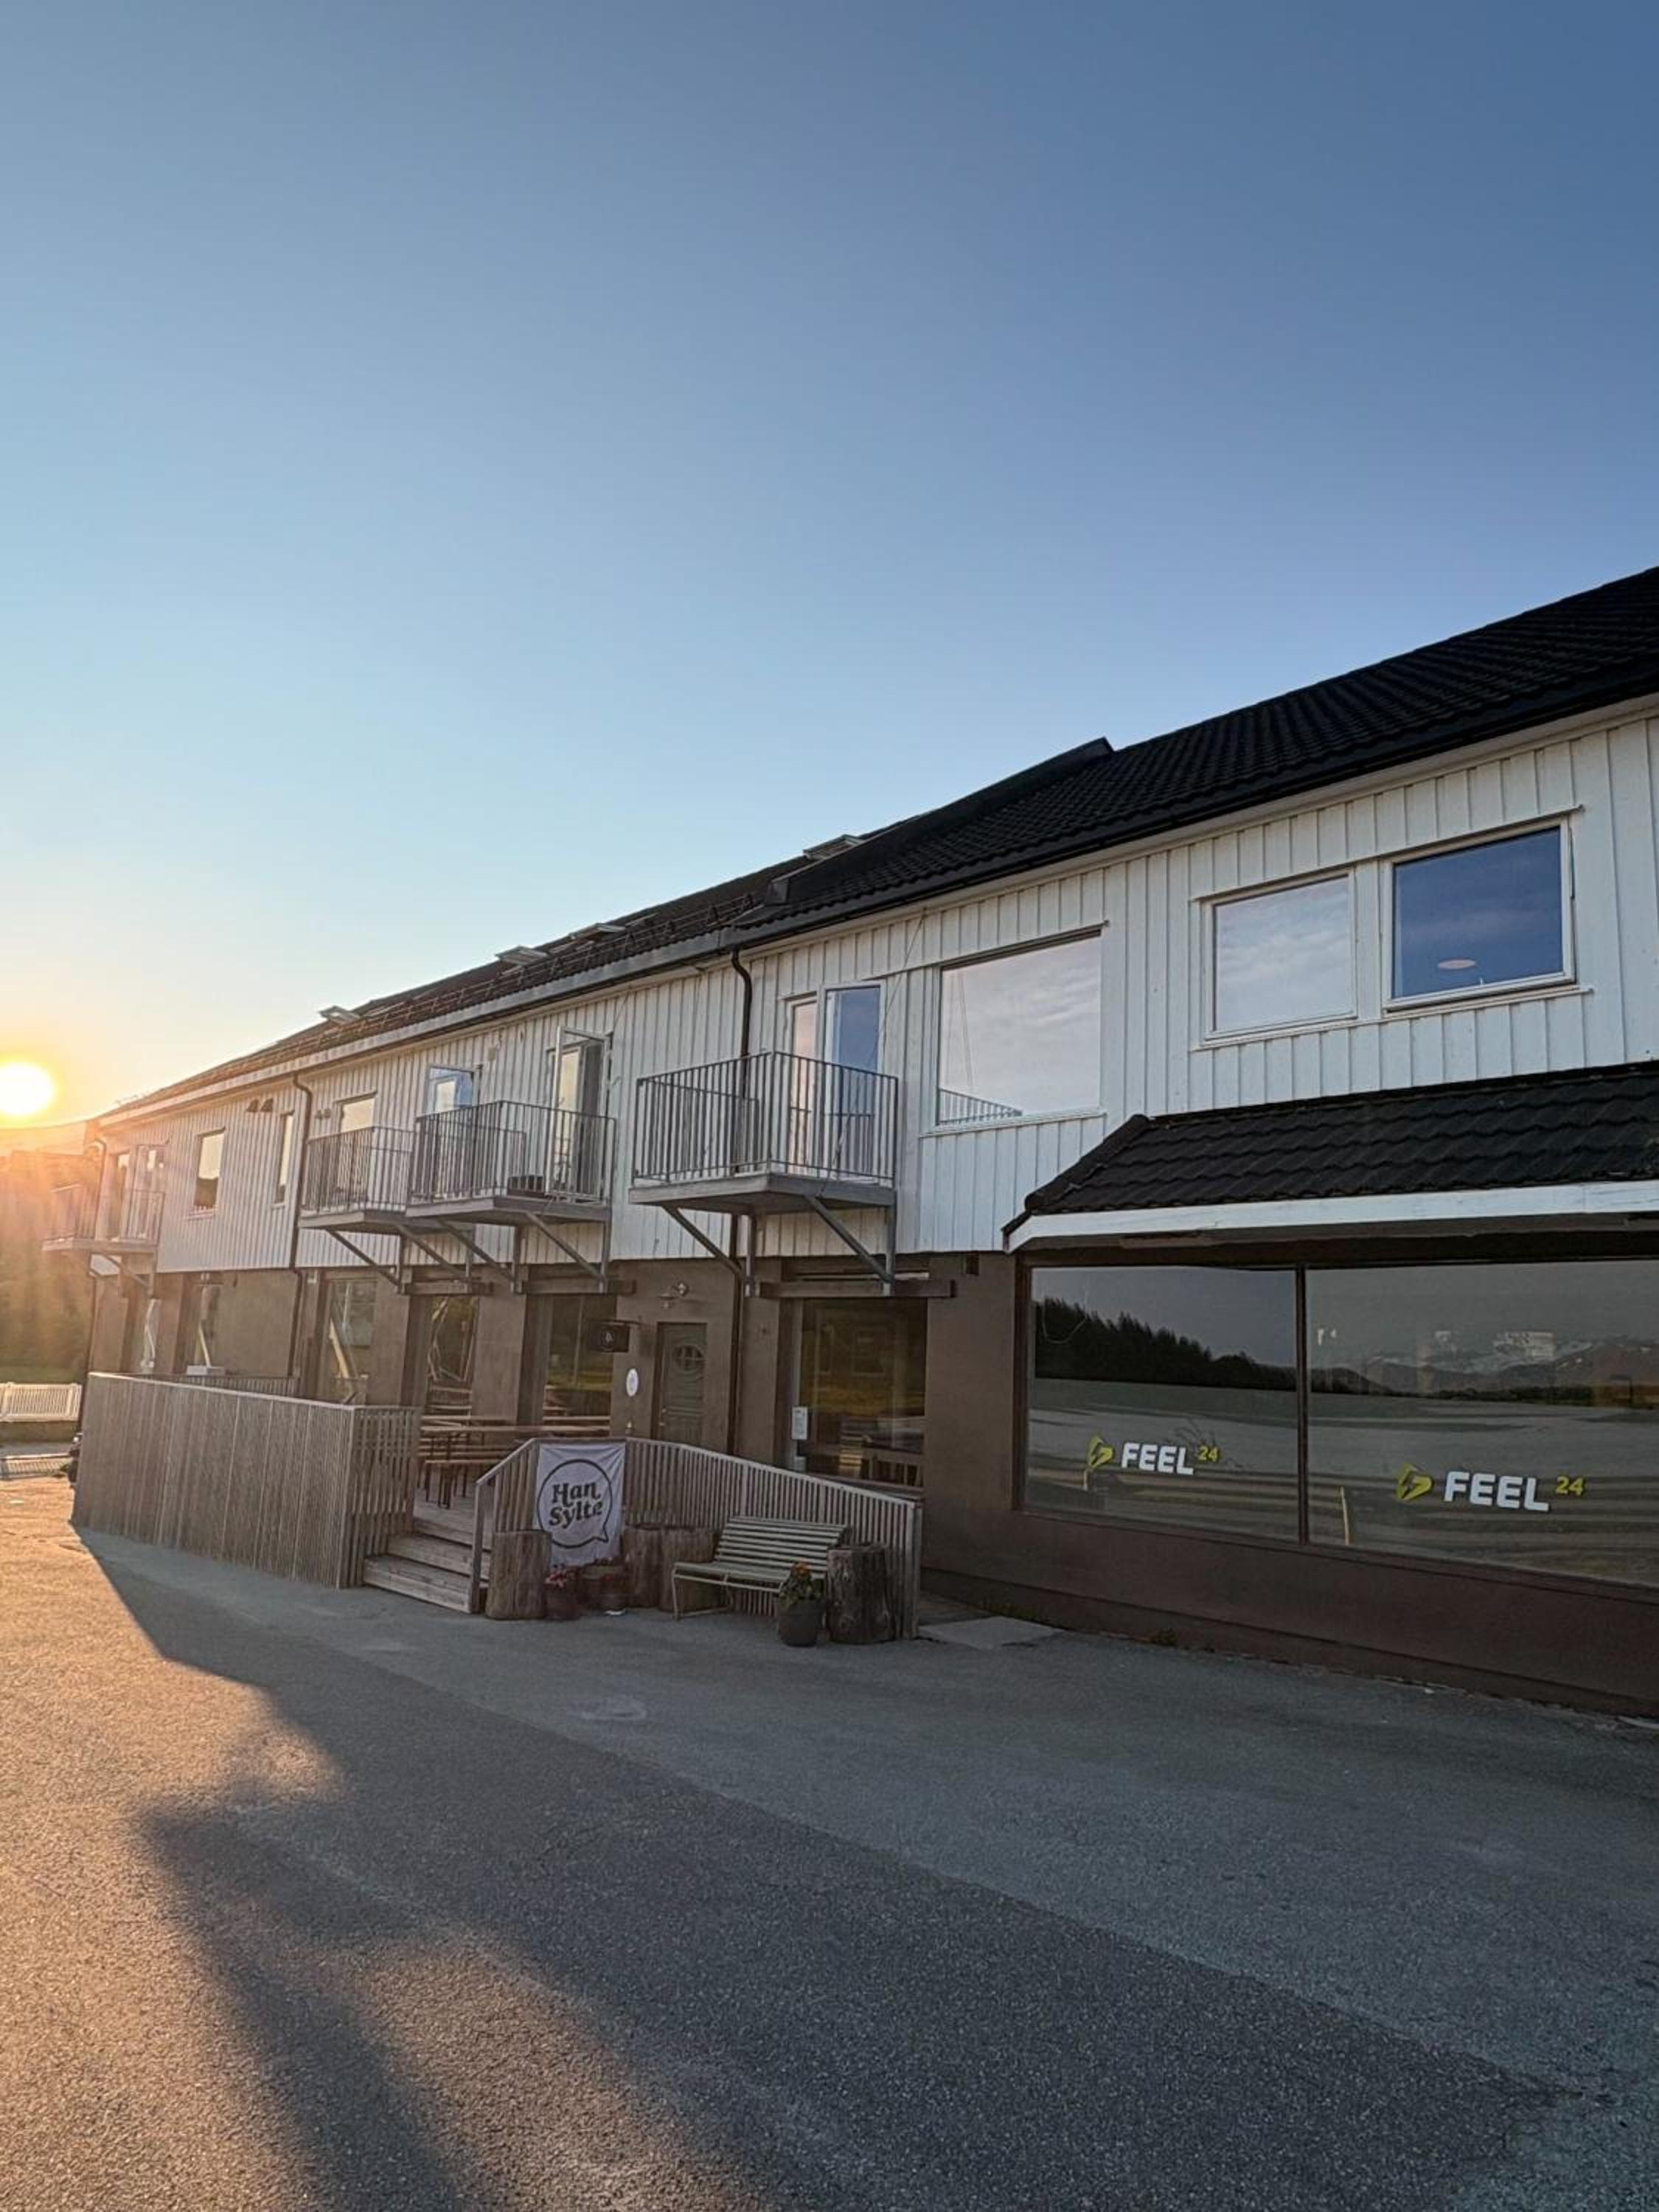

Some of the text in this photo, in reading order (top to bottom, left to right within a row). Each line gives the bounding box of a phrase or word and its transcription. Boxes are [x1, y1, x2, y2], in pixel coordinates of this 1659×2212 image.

[1121, 1442, 1220, 1475] FEEL 24
[552, 1482, 602, 1508] Han
[1444, 1471, 1585, 1512] FEEL 24
[549, 1500, 603, 1529] Sylte
